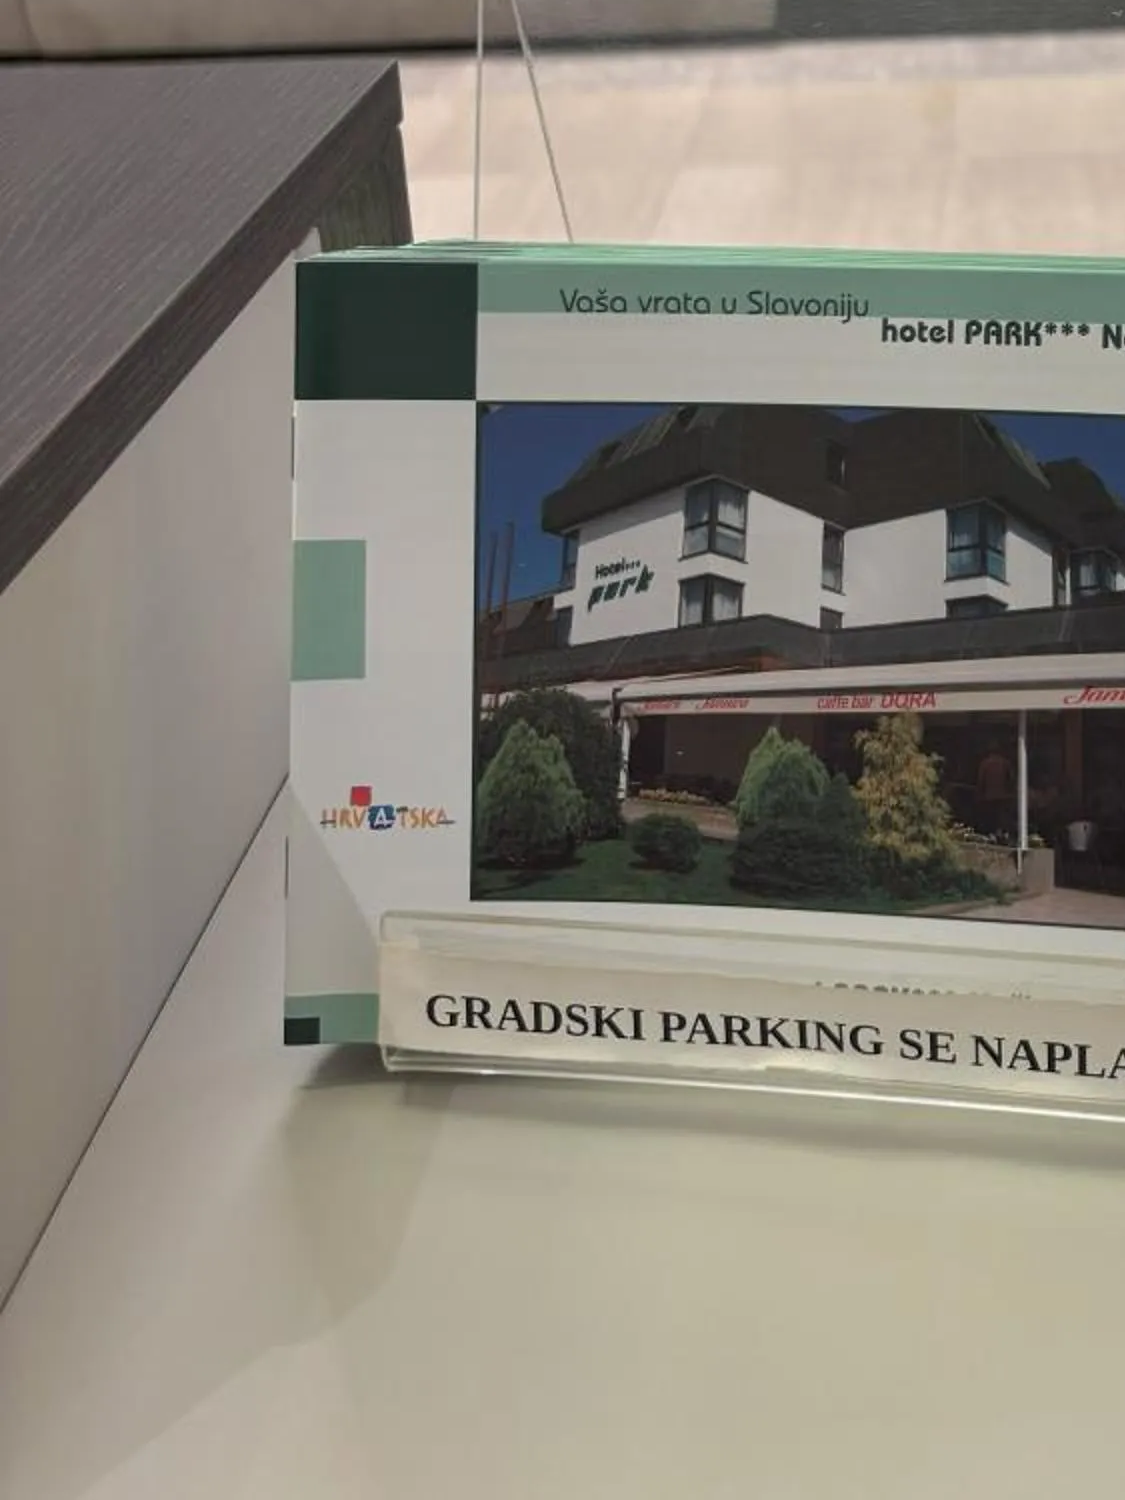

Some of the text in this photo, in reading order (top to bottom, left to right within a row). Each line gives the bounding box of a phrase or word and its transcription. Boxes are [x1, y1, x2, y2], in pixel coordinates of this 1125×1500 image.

[559, 288, 870, 324] Vaša vrata u Slavoniju
[881, 317, 955, 344] hotel
[320, 804, 456, 830] HRVATSKA
[425, 994, 646, 1041] GRADSKI
[658, 1011, 886, 1056] PARKING
[899, 1027, 957, 1064] SE
